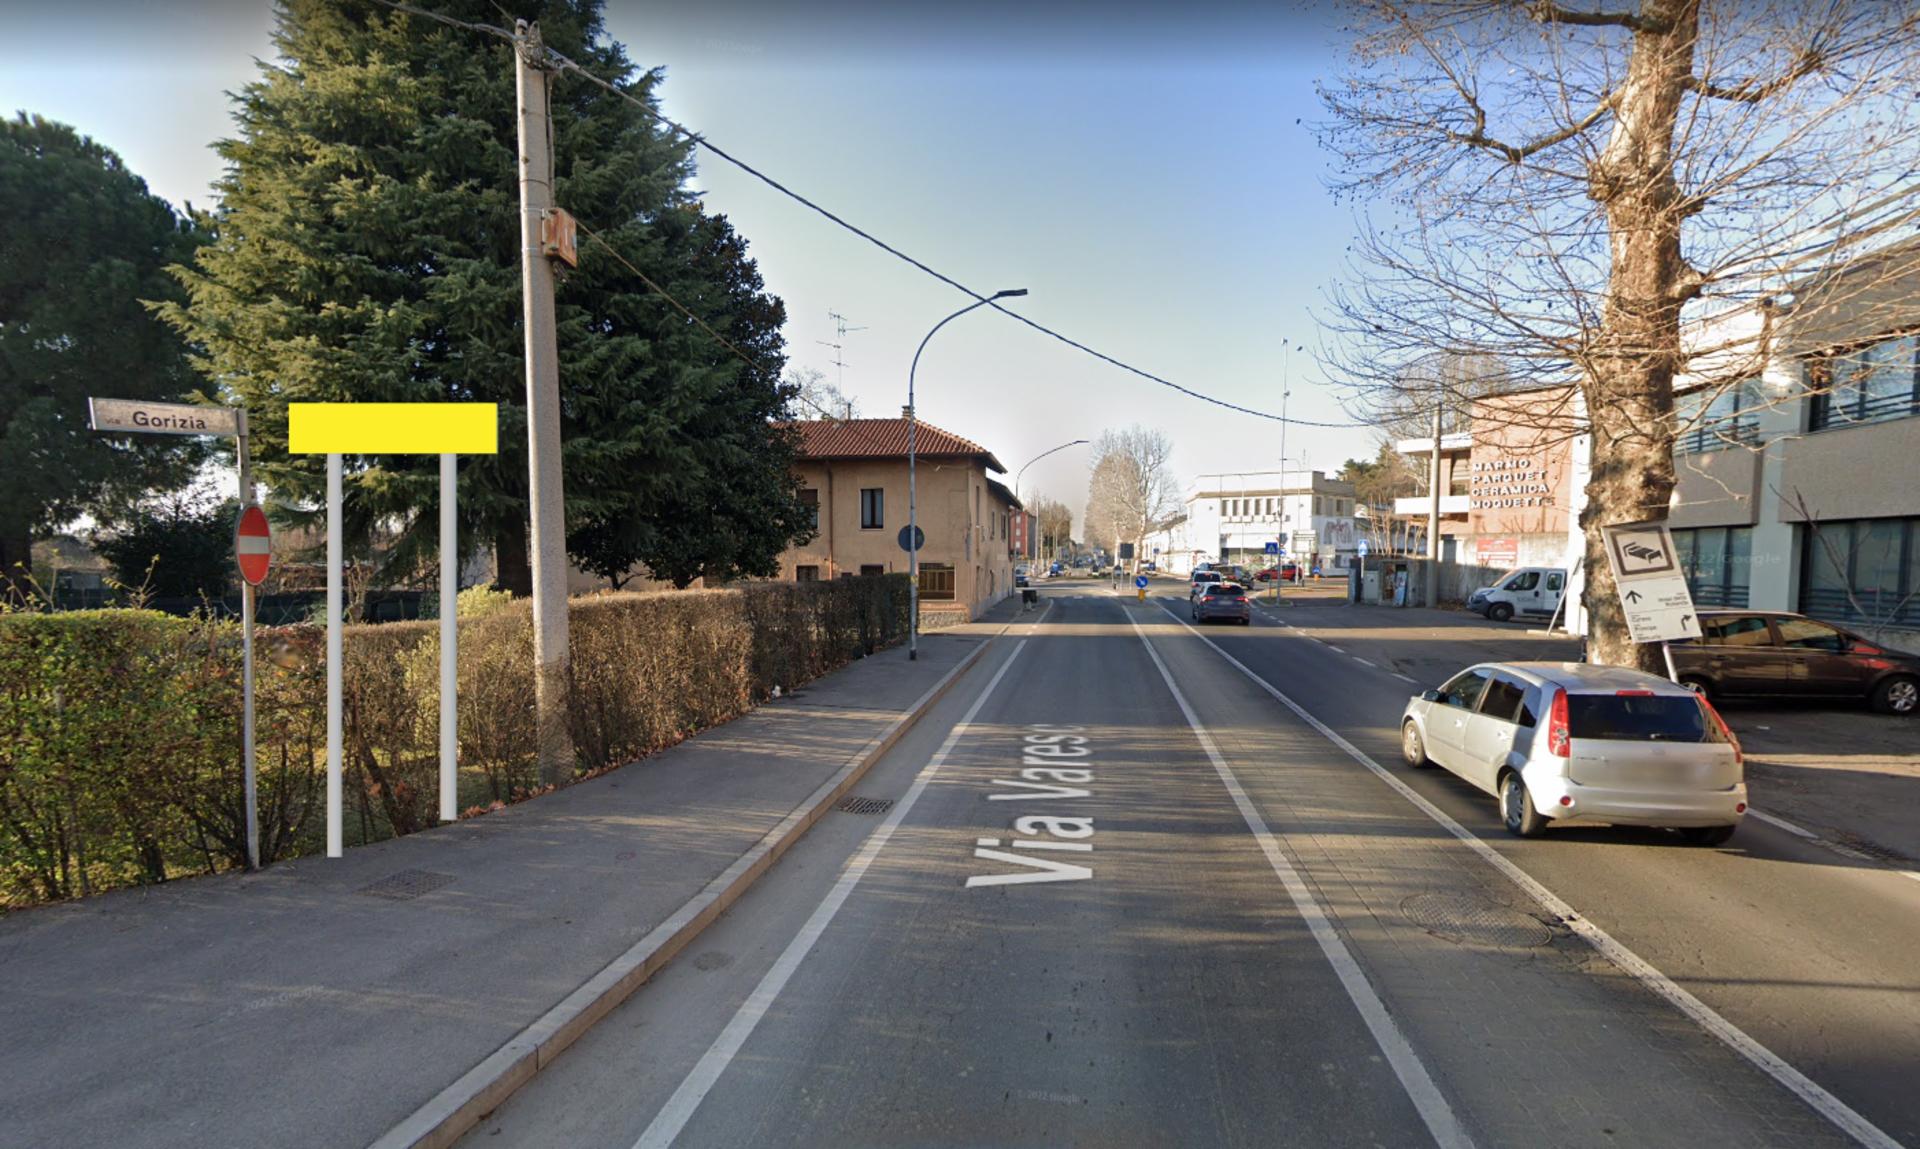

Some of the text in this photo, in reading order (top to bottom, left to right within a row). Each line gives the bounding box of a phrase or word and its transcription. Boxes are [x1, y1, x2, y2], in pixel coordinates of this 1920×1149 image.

[132, 410, 206, 430] Gorizia
[1472, 459, 1531, 472] MARMO
[1472, 470, 1548, 485] PARQUET
[1472, 483, 1550, 497] CERAMICA
